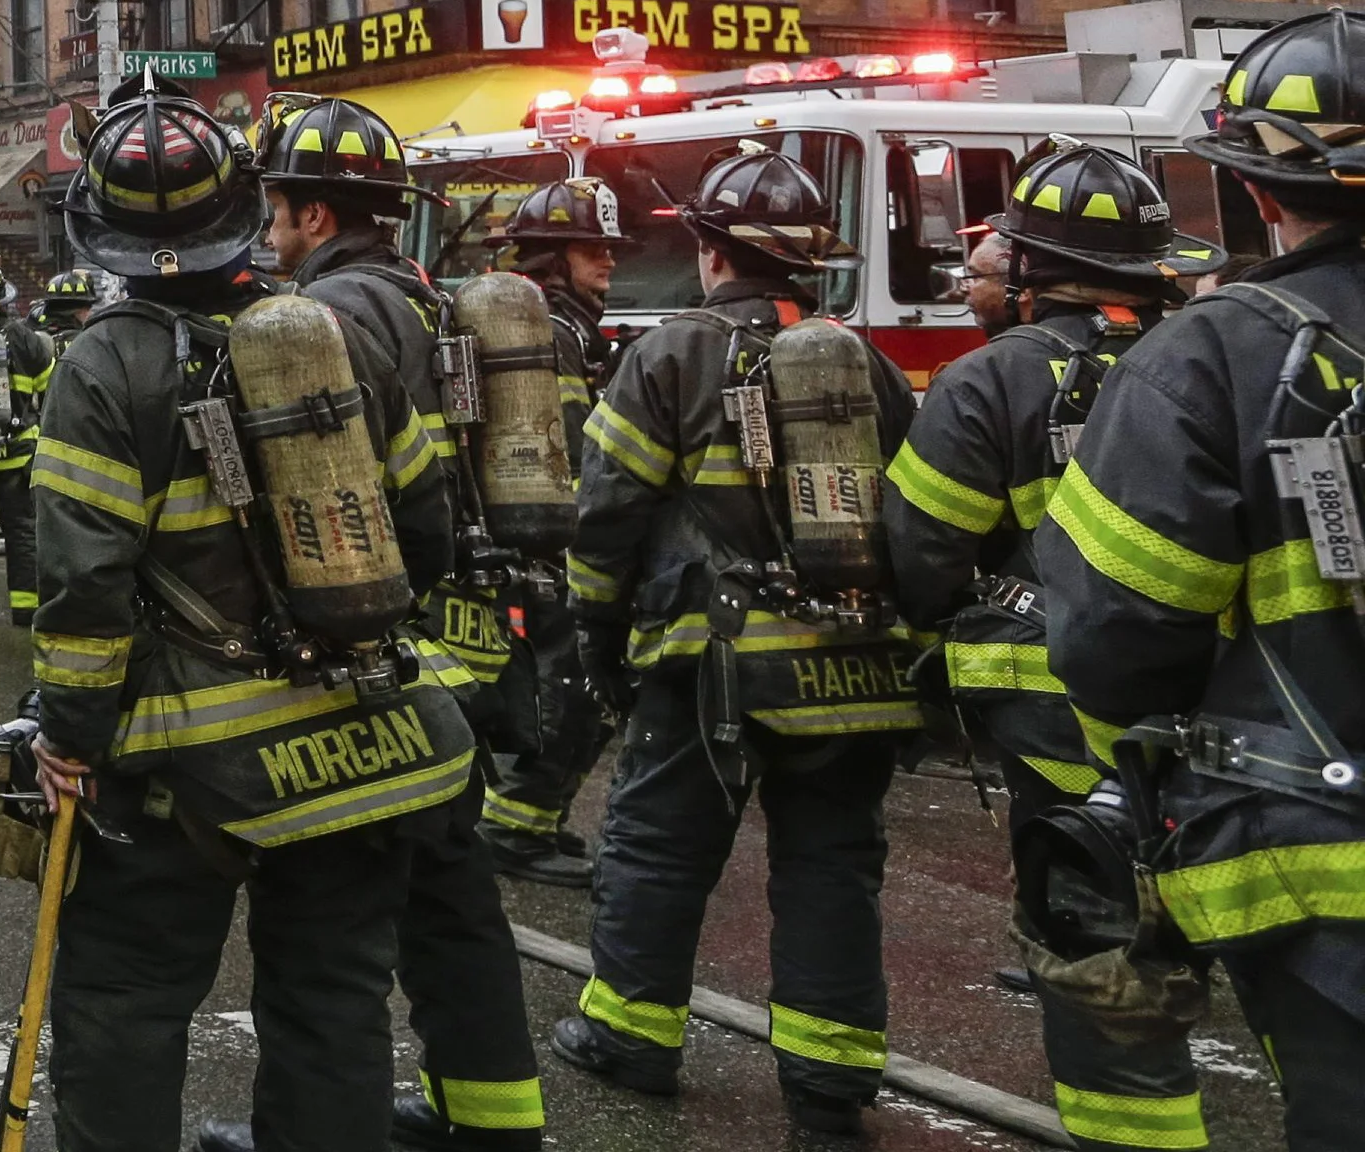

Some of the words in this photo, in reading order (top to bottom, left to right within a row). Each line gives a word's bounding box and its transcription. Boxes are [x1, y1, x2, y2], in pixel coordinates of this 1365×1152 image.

[273, 23, 348, 79] GEM
[360, 7, 433, 64] SPA
[712, 2, 812, 56] SPA
[125, 53, 141, 75] St
[148, 54, 197, 76] Marks
[202, 56, 213, 69] Pl
[334, 488, 373, 554] SCOTT
[796, 465, 819, 520] SCOTT
[826, 474, 840, 512] AIR-PAK
[836, 465, 863, 519] SCOTT
[1312, 469, 1357, 574] 1308008818
[288, 498, 326, 564] SCOTT
[257, 704, 435, 799] MORGAN
